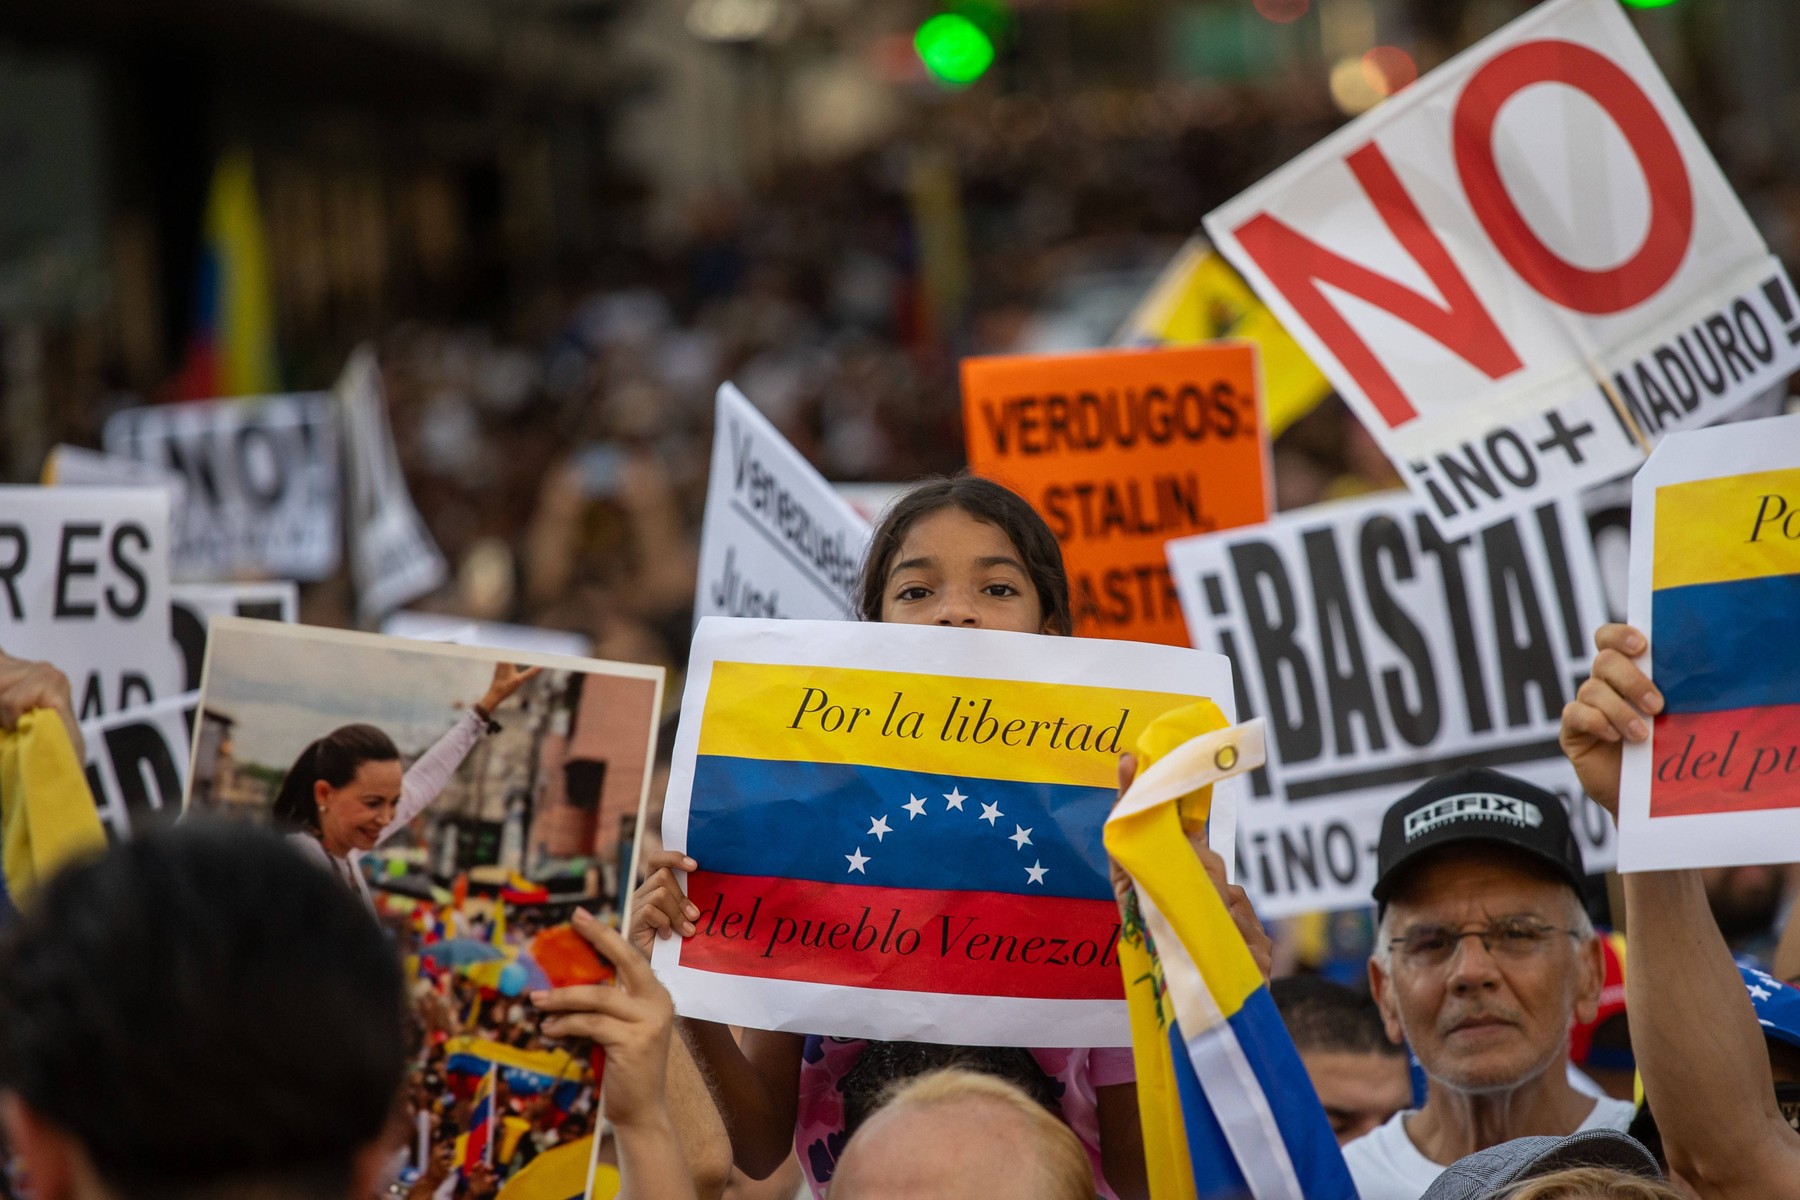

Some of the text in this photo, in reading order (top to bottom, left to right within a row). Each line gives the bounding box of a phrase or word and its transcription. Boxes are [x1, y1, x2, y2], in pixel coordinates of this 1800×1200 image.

[1231, 38, 1694, 430] NO
[54, 523, 151, 620] ES
[786, 687, 1130, 754] Por la libertad
[1657, 731, 1739, 784] del
[1408, 796, 1520, 830] REFIX
[1253, 822, 1379, 894] ¡NO
[694, 893, 762, 941] del
[760, 906, 921, 958] pueblo
